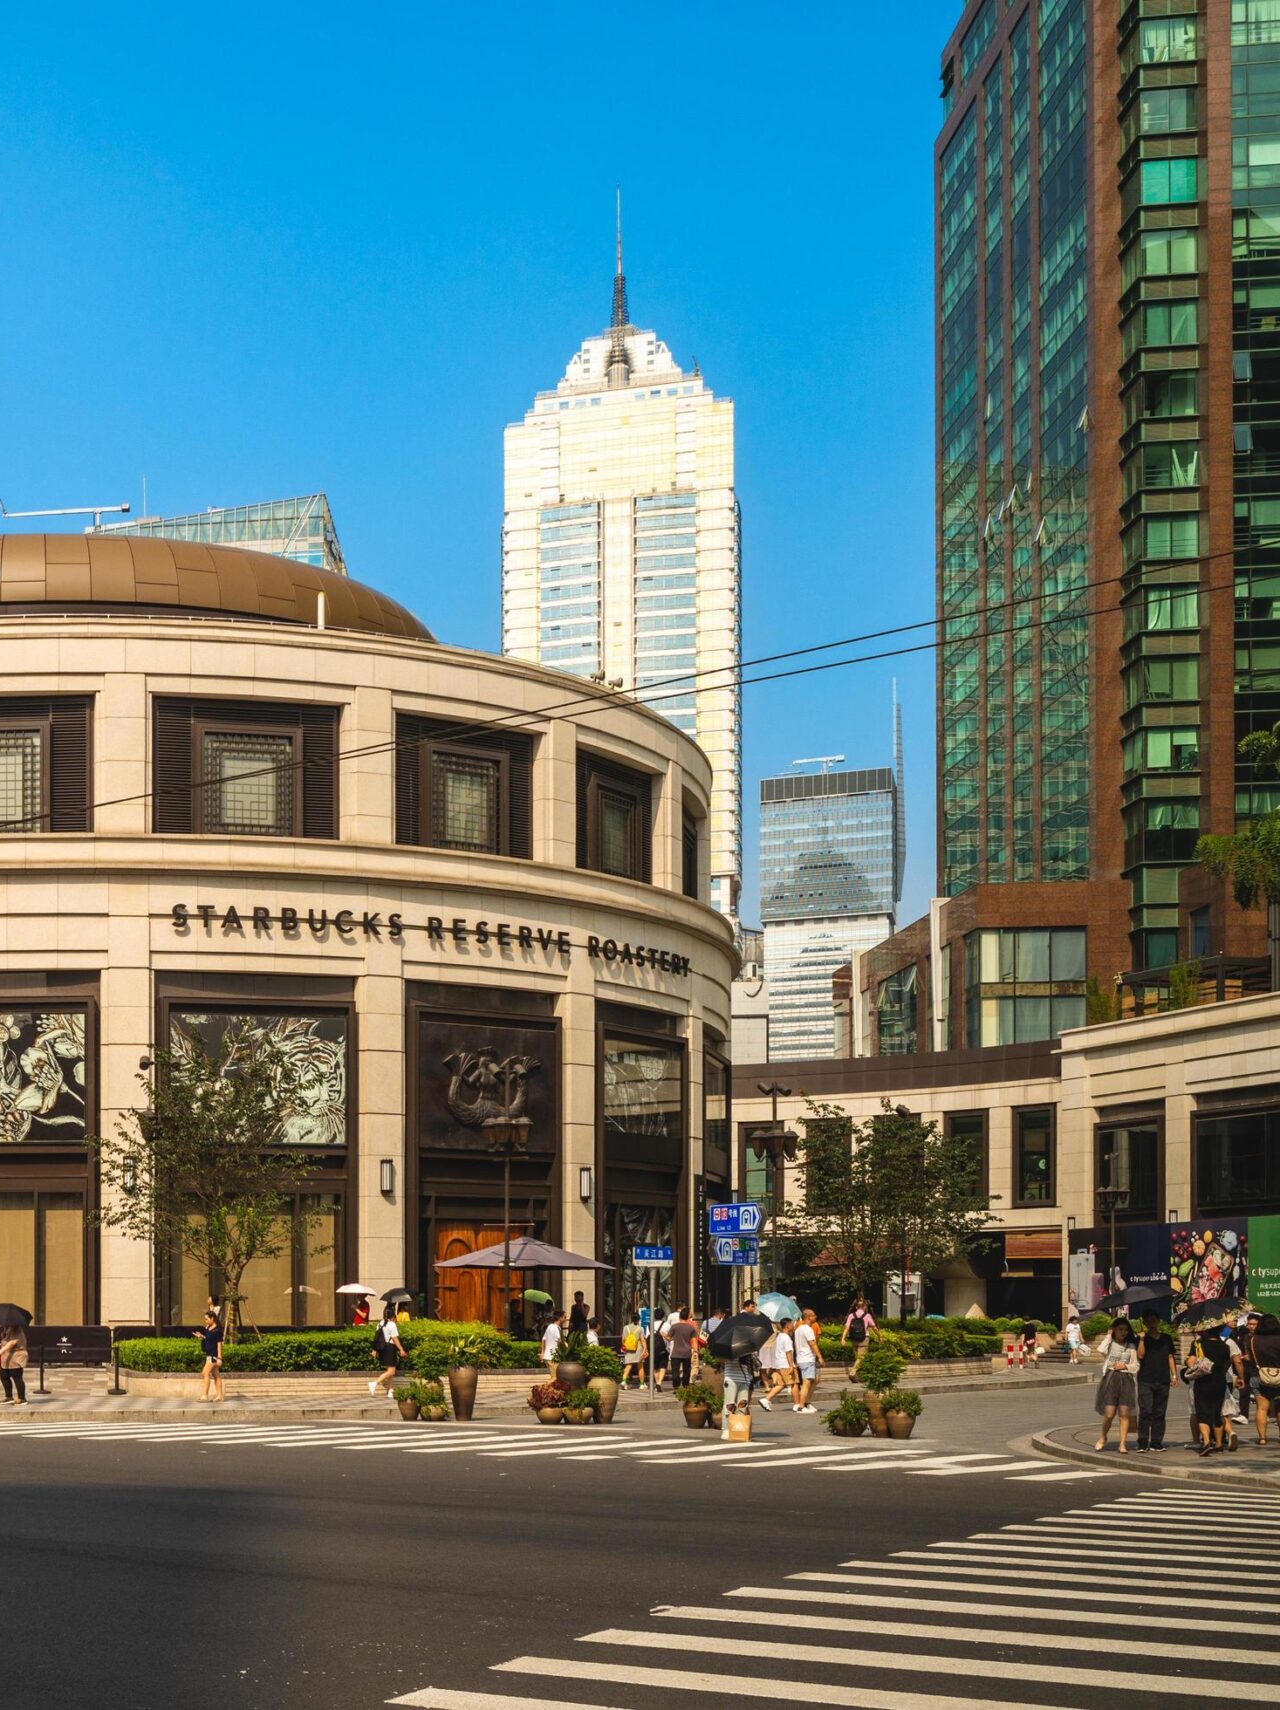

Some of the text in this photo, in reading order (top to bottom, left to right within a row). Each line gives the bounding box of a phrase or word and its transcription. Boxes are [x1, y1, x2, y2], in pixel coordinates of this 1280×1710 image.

[172, 903, 690, 977] STARBUCKS RESERVE ROASTERY
